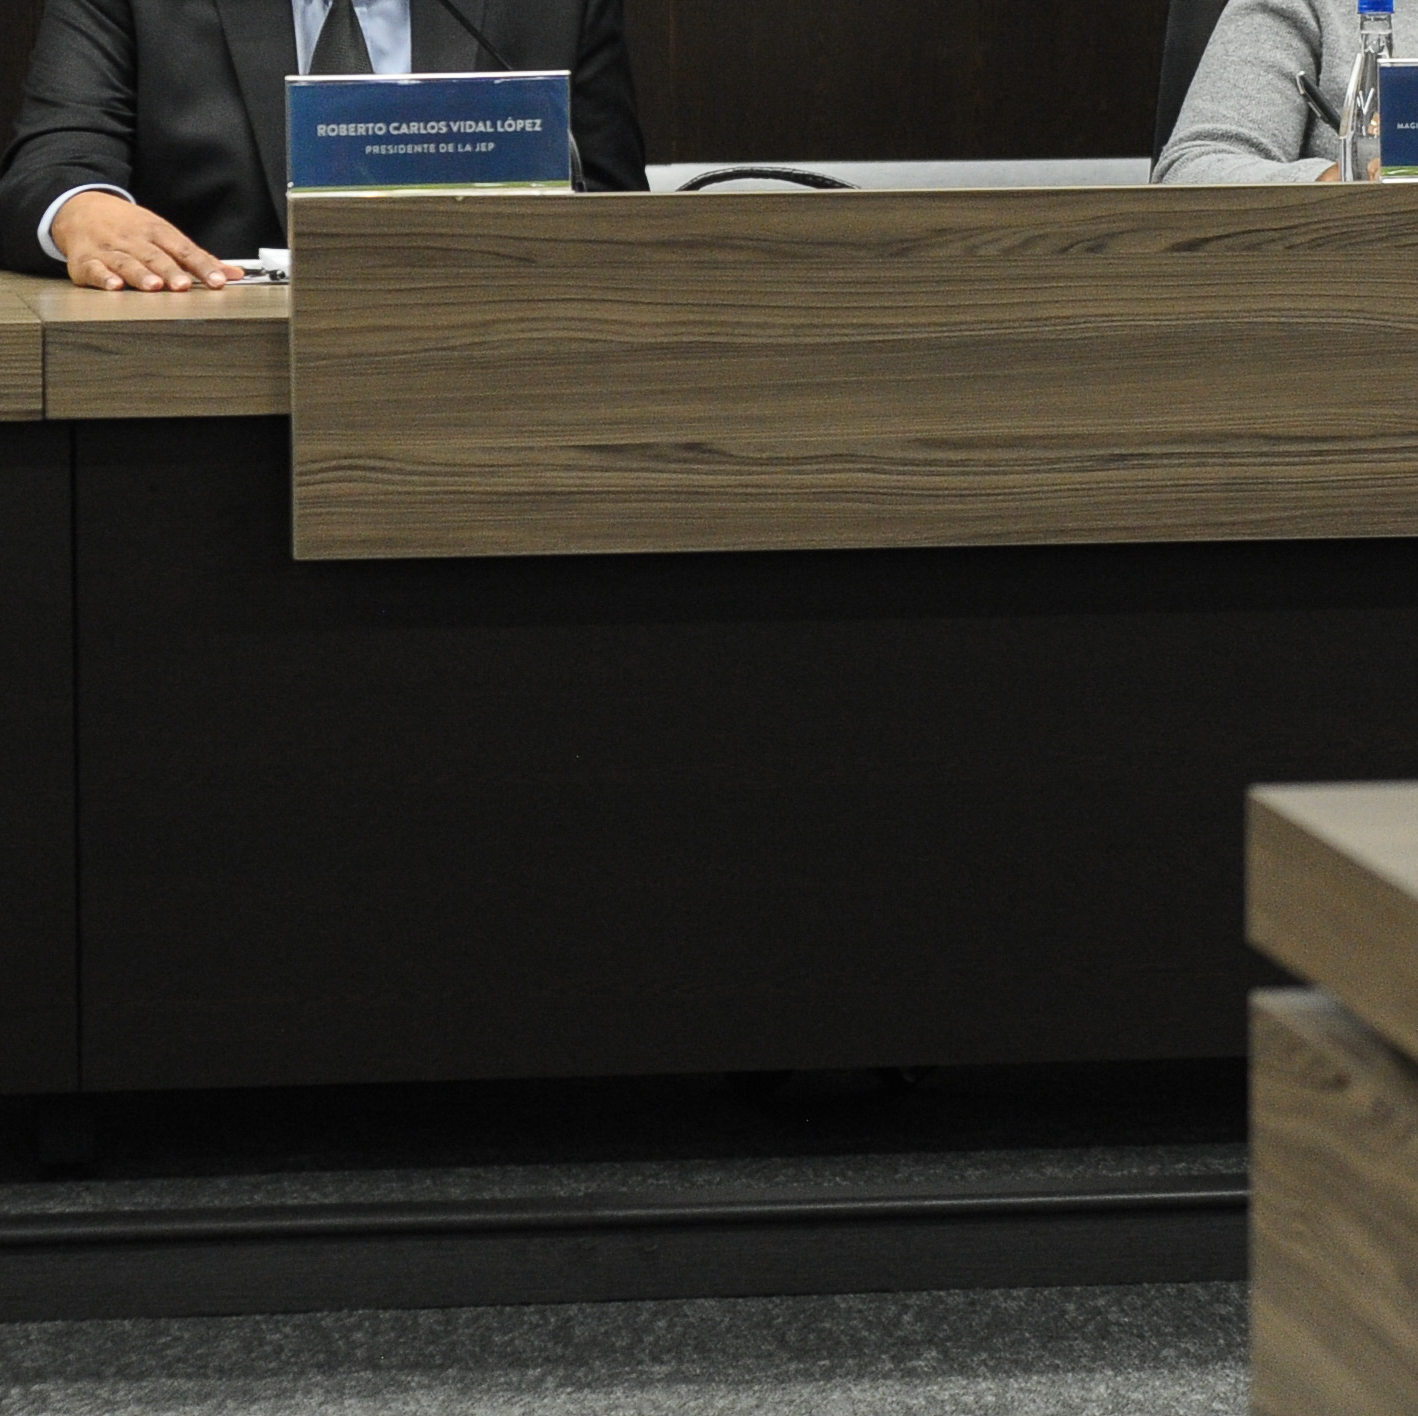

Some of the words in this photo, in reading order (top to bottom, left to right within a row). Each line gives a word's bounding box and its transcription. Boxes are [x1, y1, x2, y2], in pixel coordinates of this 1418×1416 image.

[317, 123, 386, 137] ROBERTO
[389, 121, 447, 134] CARLOS
[448, 120, 494, 133] VIDAL
[497, 117, 542, 132] LÓPEZ
[365, 144, 435, 154] PRESIDENTE
[440, 143, 453, 152] DE
[458, 143, 472, 152] LA
[475, 142, 495, 152] JEP
